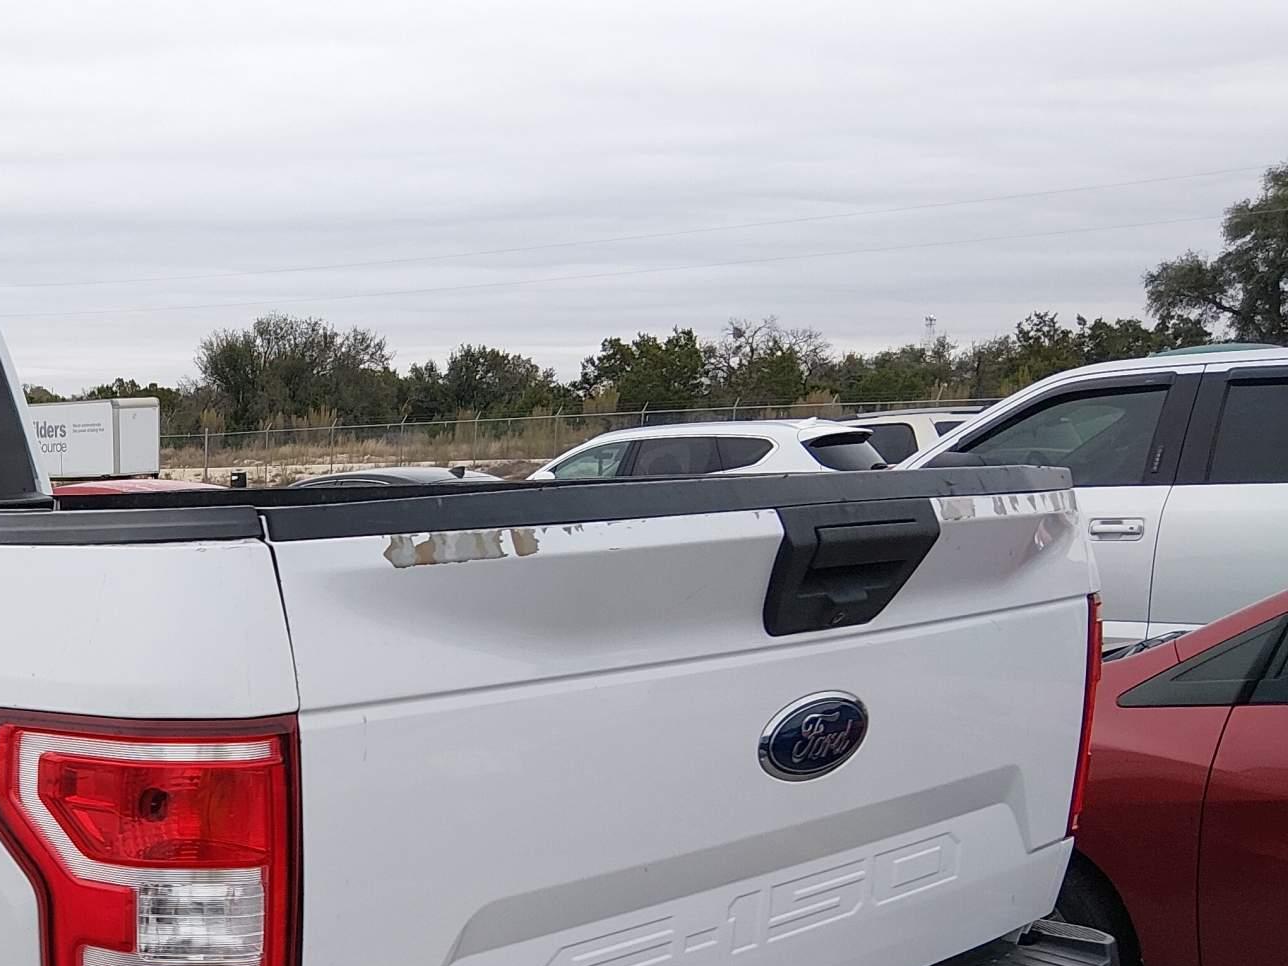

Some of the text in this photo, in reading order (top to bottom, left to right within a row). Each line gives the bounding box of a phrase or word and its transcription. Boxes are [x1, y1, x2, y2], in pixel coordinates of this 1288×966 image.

[32, 420, 67, 439] lders
[38, 440, 68, 453] ource
[792, 711, 853, 763] Ford
